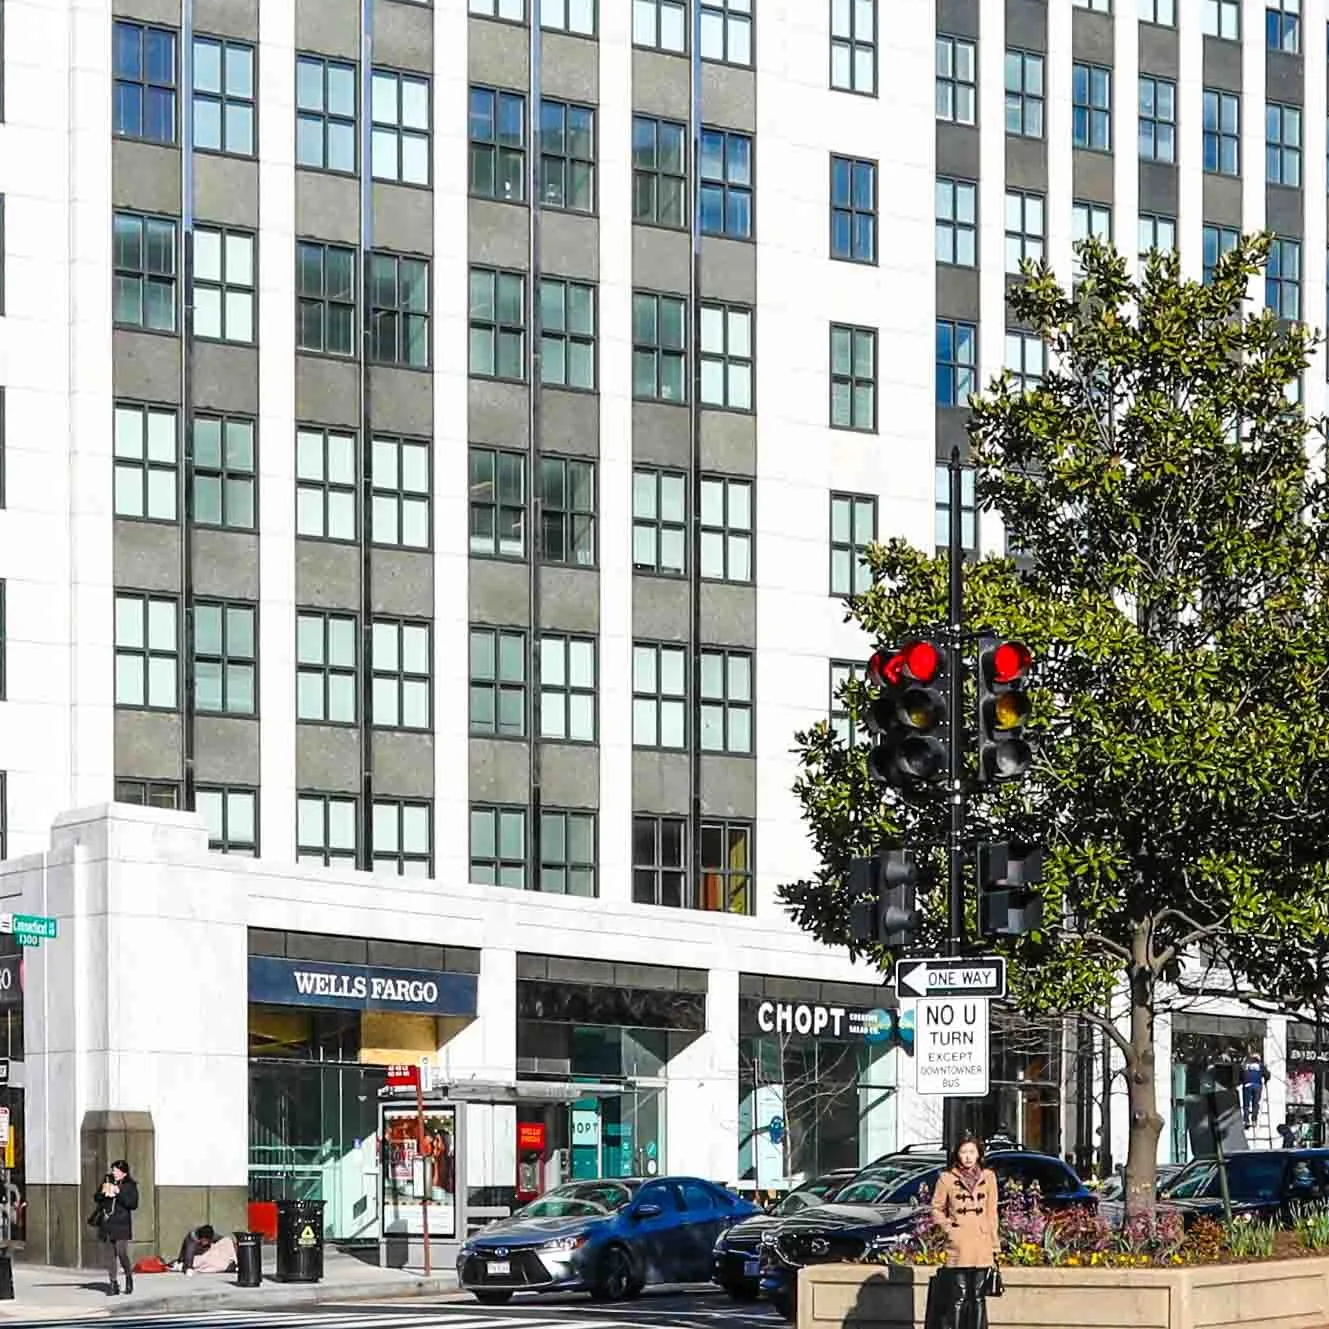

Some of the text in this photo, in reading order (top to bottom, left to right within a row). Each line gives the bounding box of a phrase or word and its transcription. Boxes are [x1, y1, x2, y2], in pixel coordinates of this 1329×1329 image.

[928, 971, 991, 986] ONE WAY
[294, 972, 438, 1003] WELLS FARGO
[758, 1002, 845, 1036] CHOPT
[926, 1004, 976, 1025] NO U
[930, 1031, 974, 1046] TURN
[928, 1052, 973, 1062] EXCEPT
[920, 1065, 983, 1075] DOWNTOWNER
